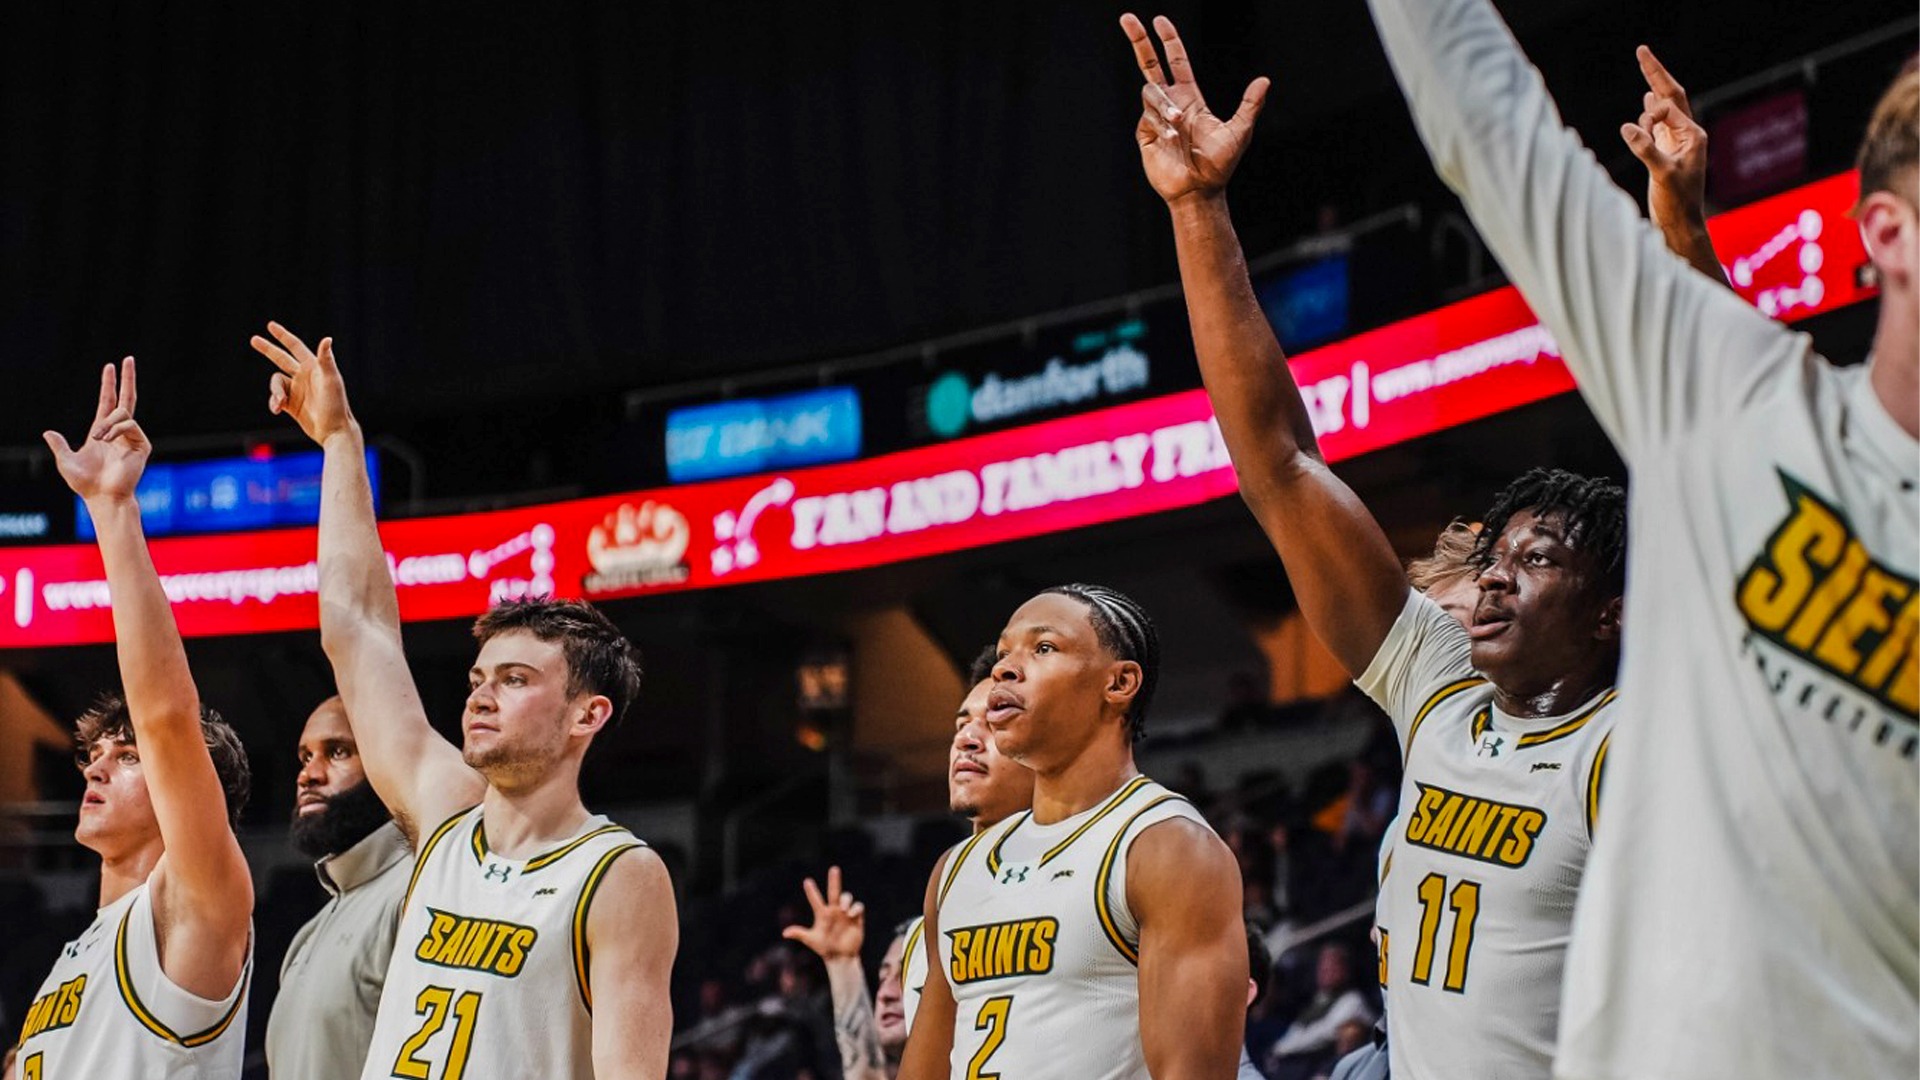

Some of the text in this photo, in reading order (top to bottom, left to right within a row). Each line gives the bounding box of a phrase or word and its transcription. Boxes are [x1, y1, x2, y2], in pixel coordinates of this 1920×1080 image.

[971, 346, 1145, 422] danforth
[792, 487, 886, 549] FAN
[886, 470, 980, 534] AND
[981, 433, 1152, 516] FAMILY
[1735, 465, 1920, 722] SIEN
[1406, 781, 1547, 868] SAINTS
[416, 908, 537, 977] SAINTS
[947, 917, 1058, 983] SAINTS
[1411, 872, 1481, 994] 11
[390, 985, 483, 1080] 21
[966, 995, 1013, 1080] 2
